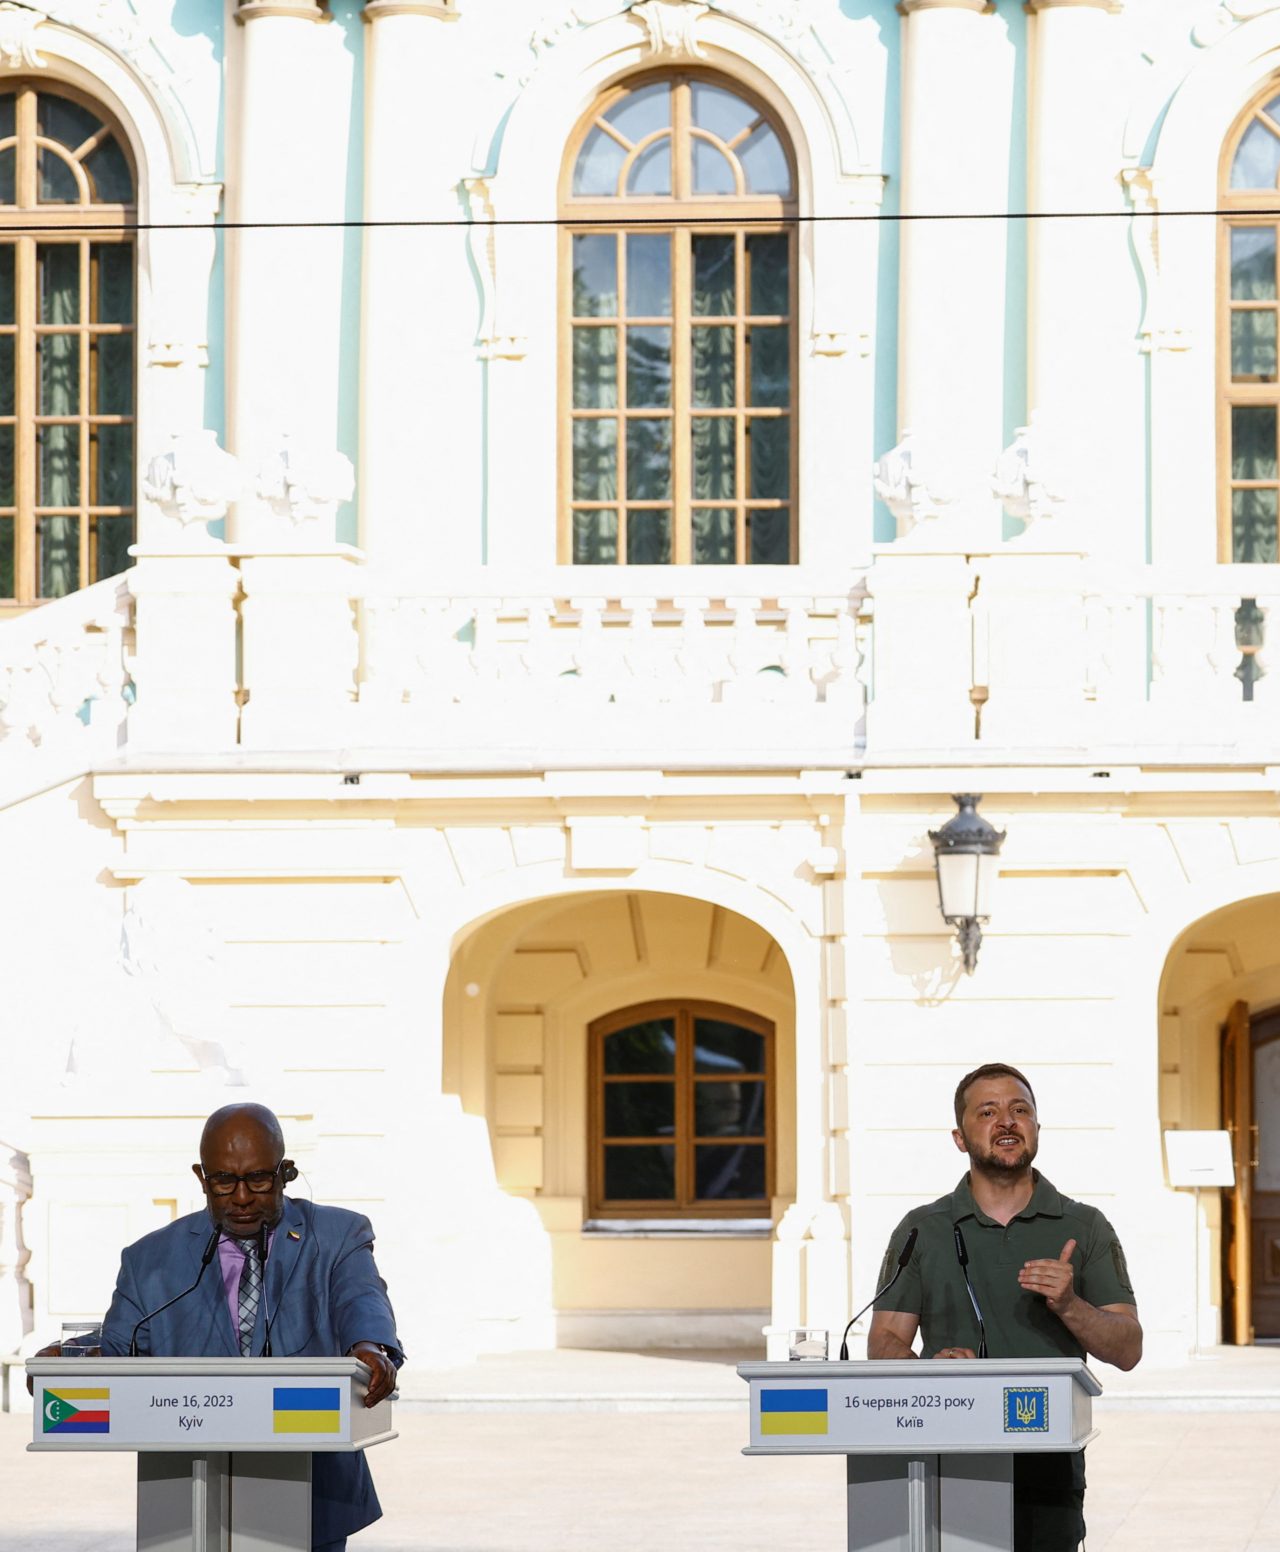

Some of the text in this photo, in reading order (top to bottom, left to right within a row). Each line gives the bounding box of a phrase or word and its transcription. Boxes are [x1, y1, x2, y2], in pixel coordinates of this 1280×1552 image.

[149, 1394, 234, 1409] June 16, 2023
[844, 1394, 975, 1411] 16 червня 2023 року
[178, 1415, 204, 1431] Kyiv
[896, 1415, 924, 1428] Київ
